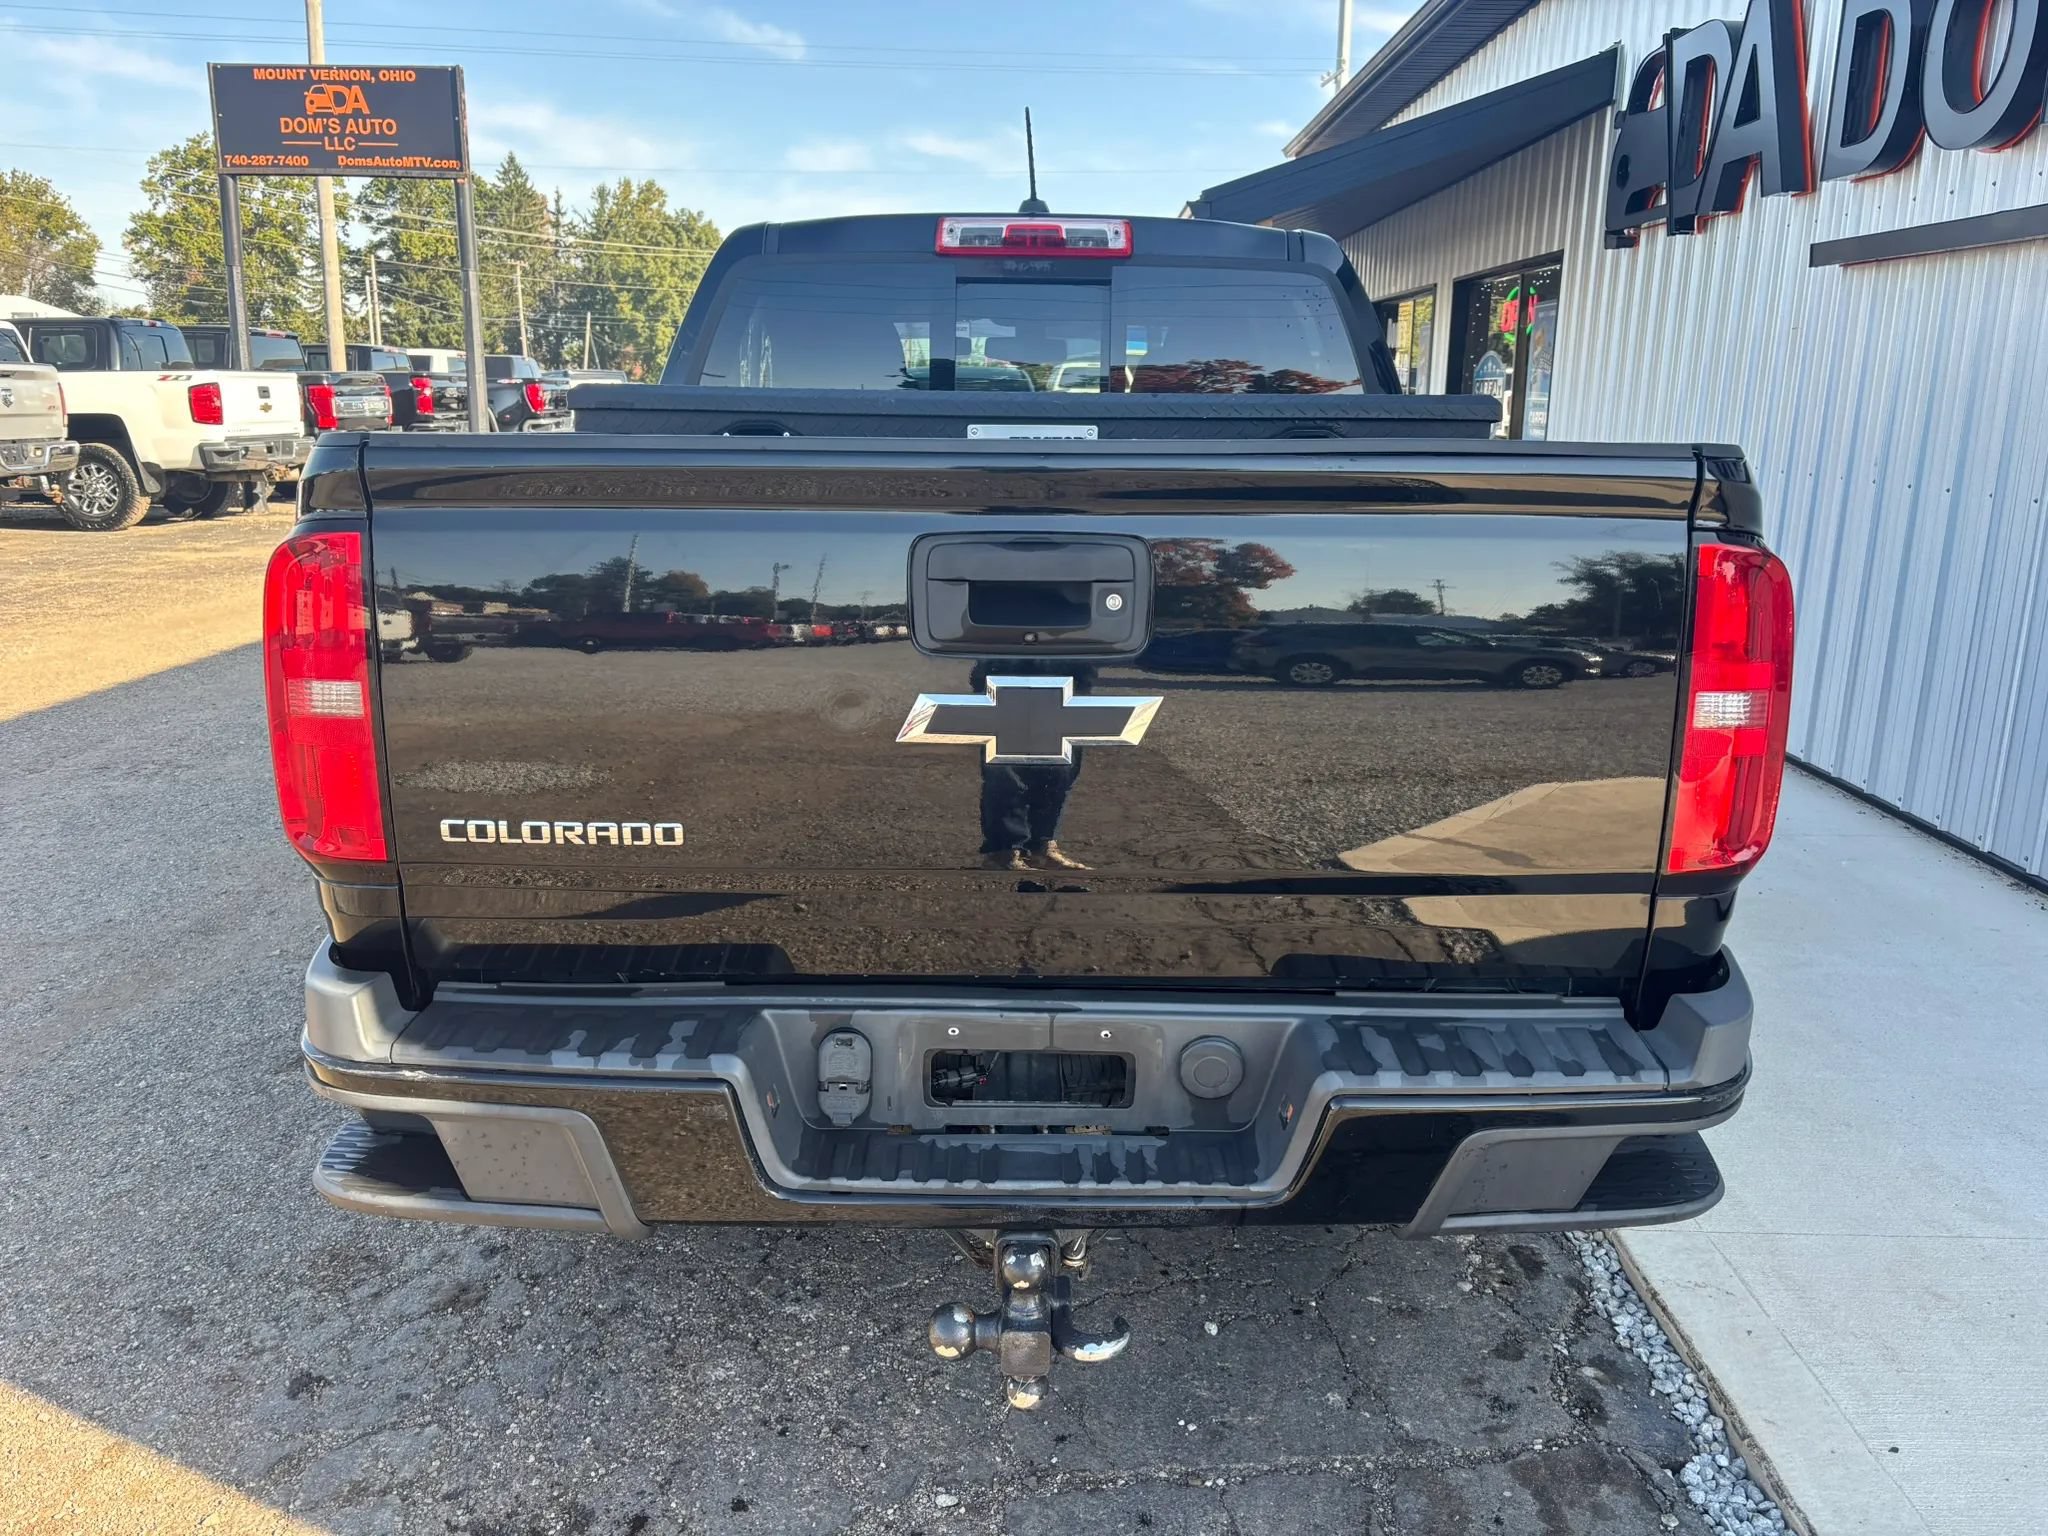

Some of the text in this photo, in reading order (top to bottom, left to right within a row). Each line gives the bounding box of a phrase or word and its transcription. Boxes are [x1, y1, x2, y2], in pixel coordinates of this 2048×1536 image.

[253, 68, 417, 84] MOUNT VERNON, OHIO
[279, 117, 398, 136] DOM'S AUTO
[324, 136, 357, 151] LLC
[223, 154, 462, 170] 740-287-7400 DomsAutoMTV.com
[1500, 294, 1538, 332] OPN
[439, 818, 685, 847] COLORADO
